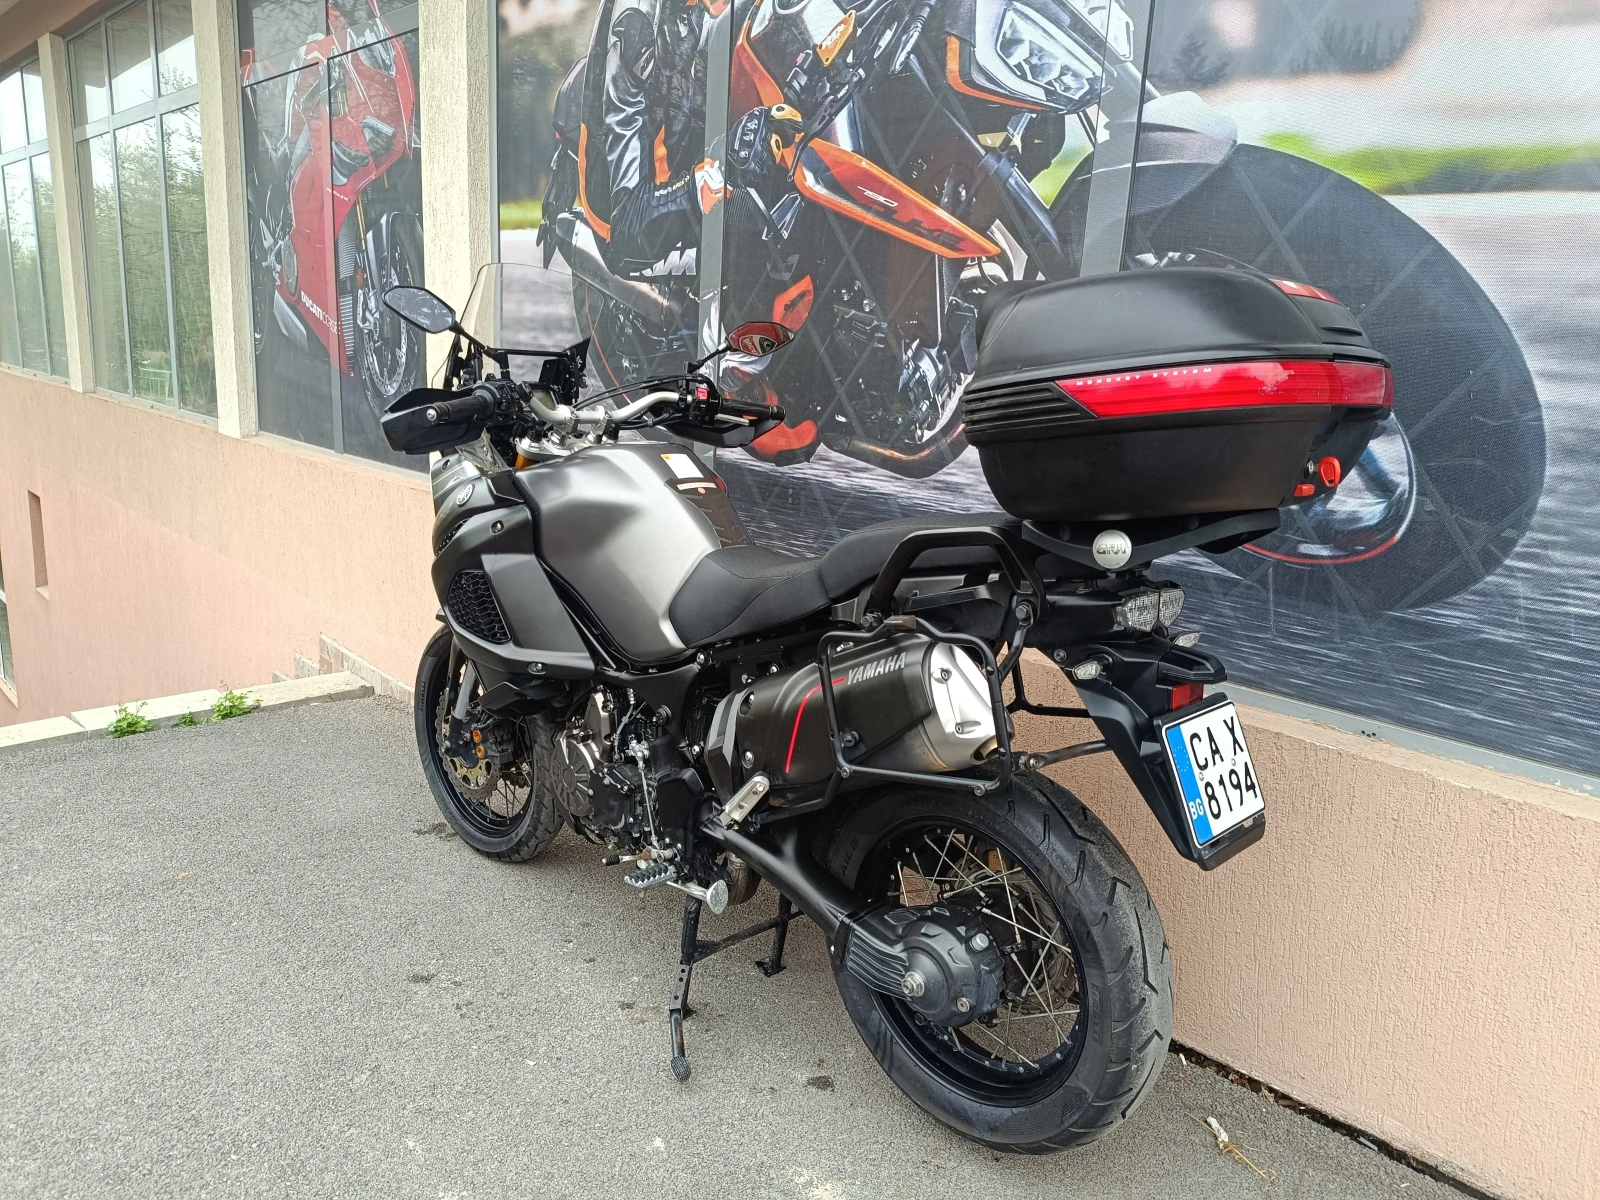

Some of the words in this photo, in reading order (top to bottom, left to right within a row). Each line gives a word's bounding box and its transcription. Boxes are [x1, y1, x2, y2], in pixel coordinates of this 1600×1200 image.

[301, 290, 324, 320] DUCATI
[1076, 375, 1141, 386] MONOKEY
[1152, 367, 1212, 378] SYSTEM
[847, 651, 906, 686] YAMAHA
[1189, 726, 1224, 772] CA
[1223, 716, 1244, 756] X
[1204, 761, 1258, 820] 8194
[1188, 797, 1204, 820] BG
